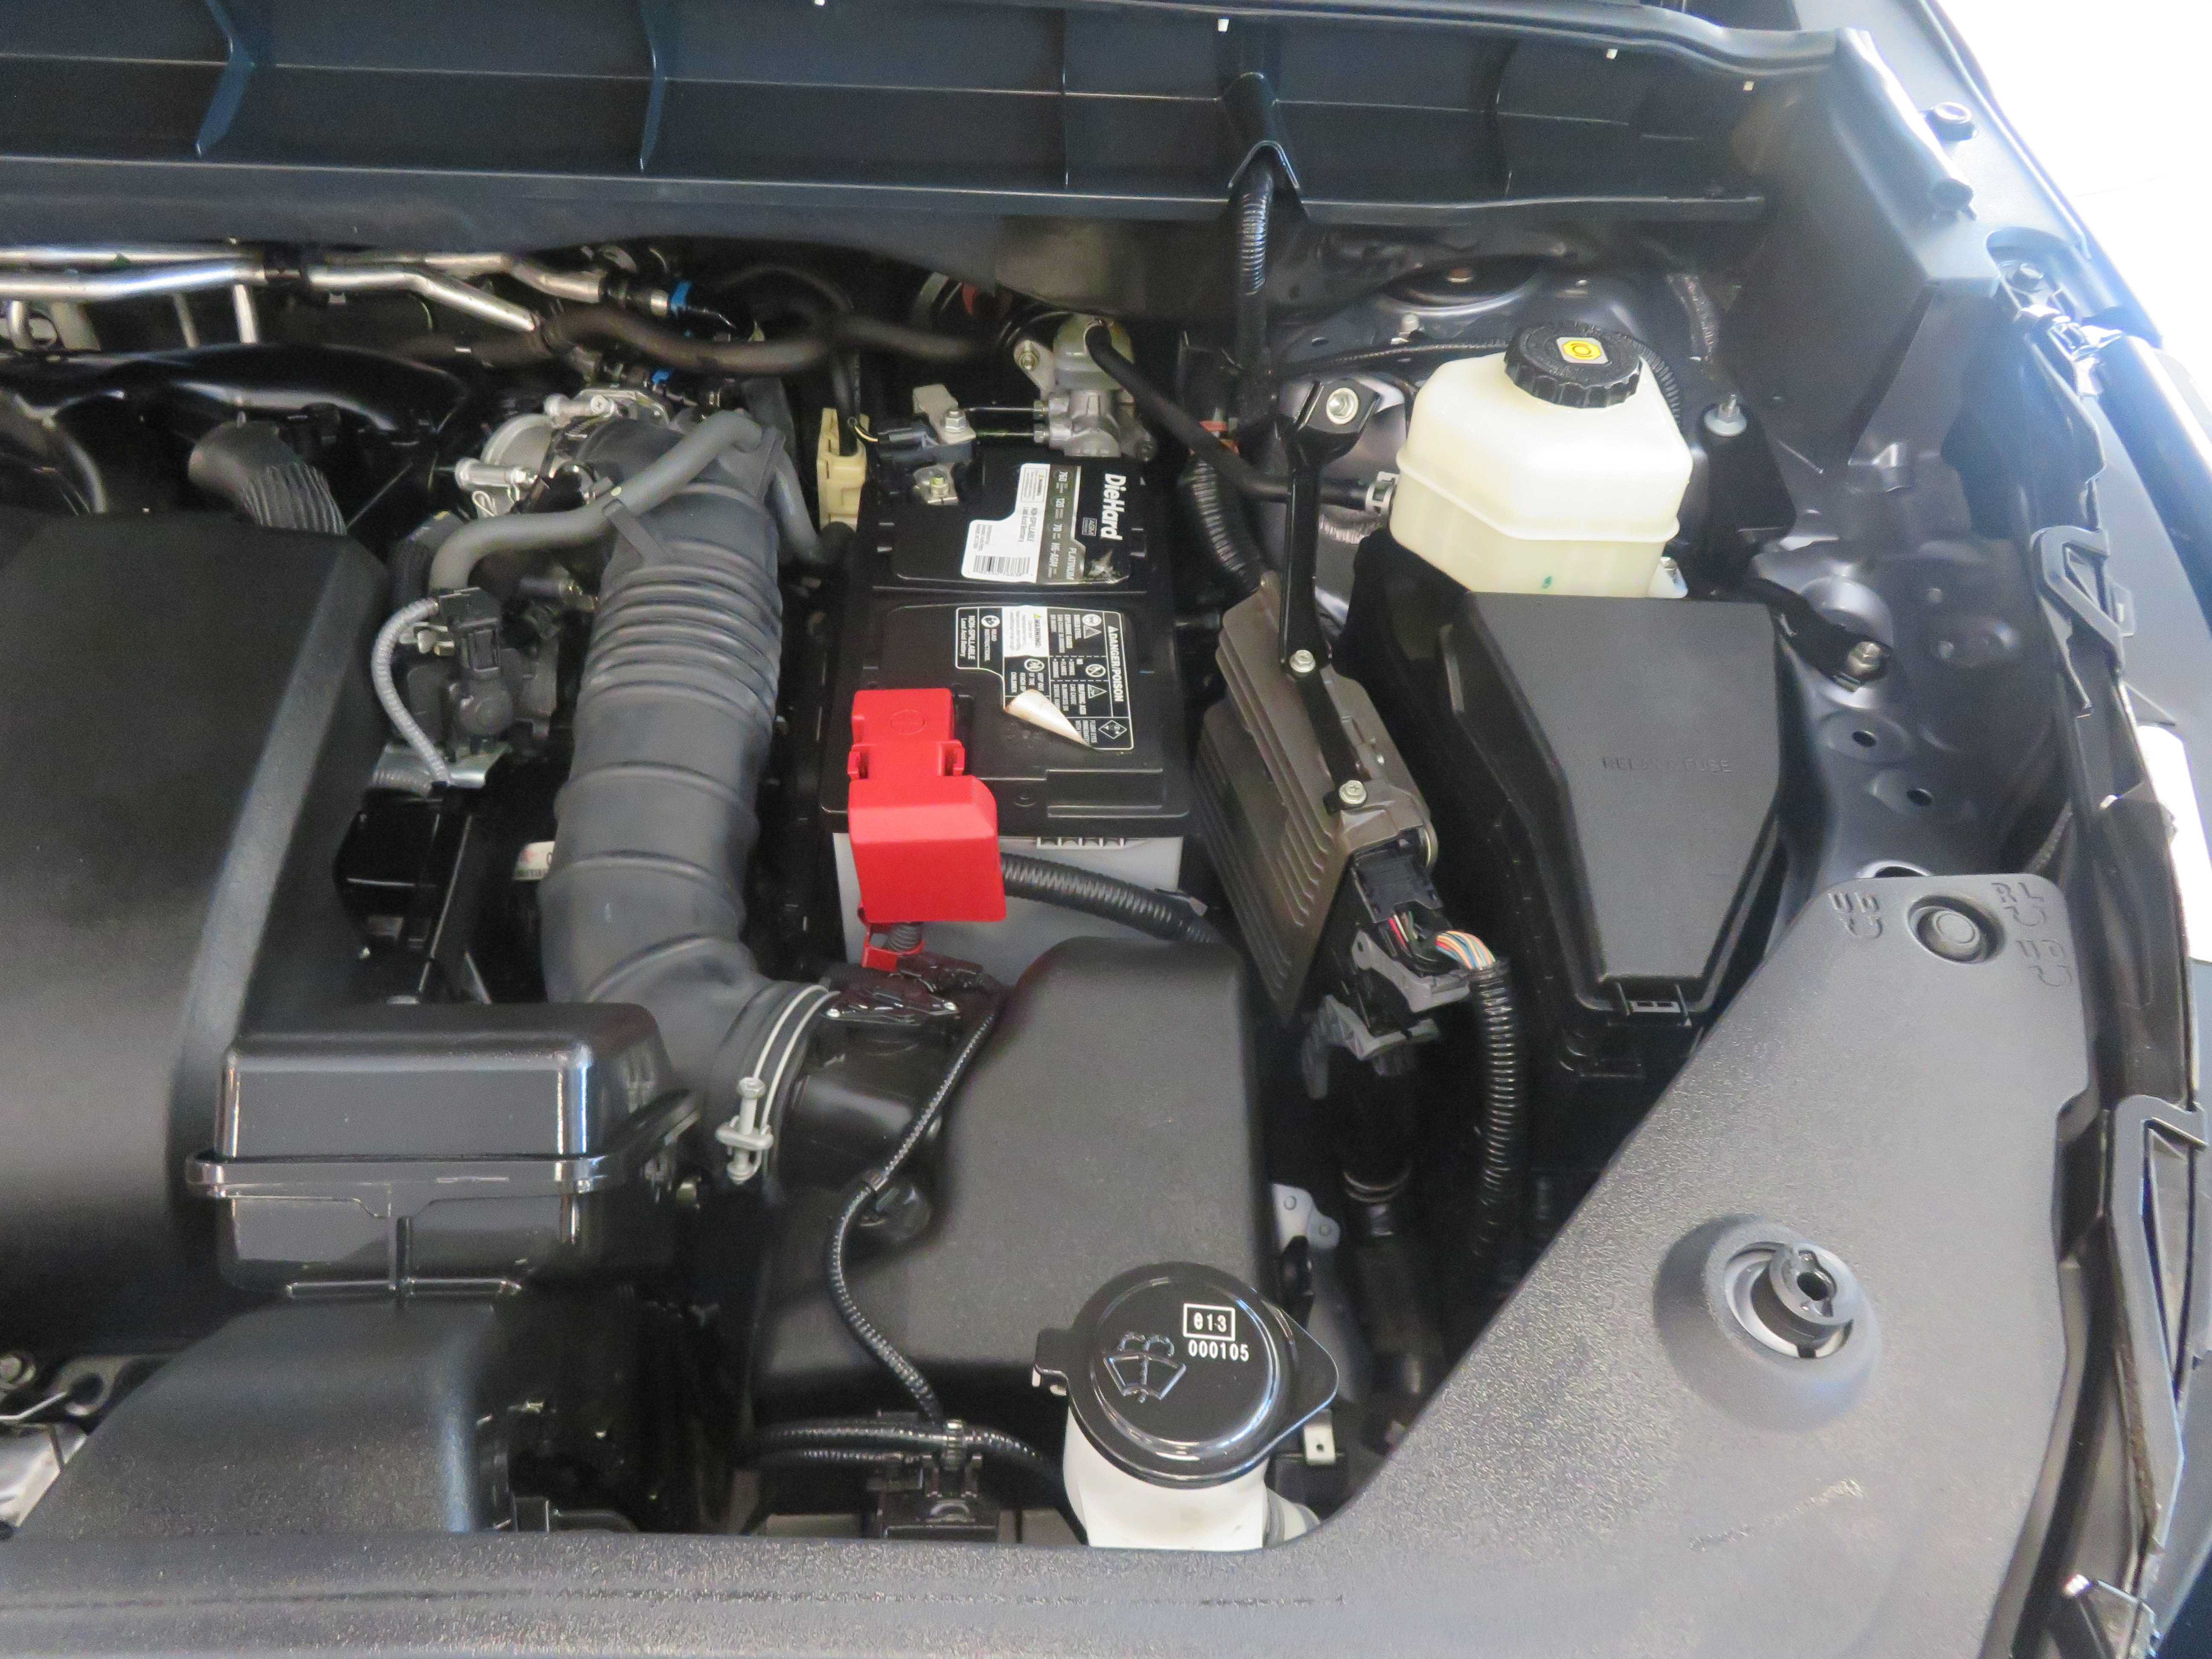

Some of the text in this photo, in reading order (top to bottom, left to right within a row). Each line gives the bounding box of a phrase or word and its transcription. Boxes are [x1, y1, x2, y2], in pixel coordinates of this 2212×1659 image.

[1059, 471, 1068, 482] 760
[1056, 498, 1065, 508] 120
[1100, 474, 1127, 541] DieHard
[1027, 508, 1038, 542] NON-SPILLABLE
[1049, 543, 1060, 567] H6-AGM
[1066, 547, 1077, 580] PLATINUM
[1109, 634, 1123, 701] DANGER/POISON
[1193, 1311, 1227, 1333] e13
[1187, 1340, 1250, 1362] 000105
